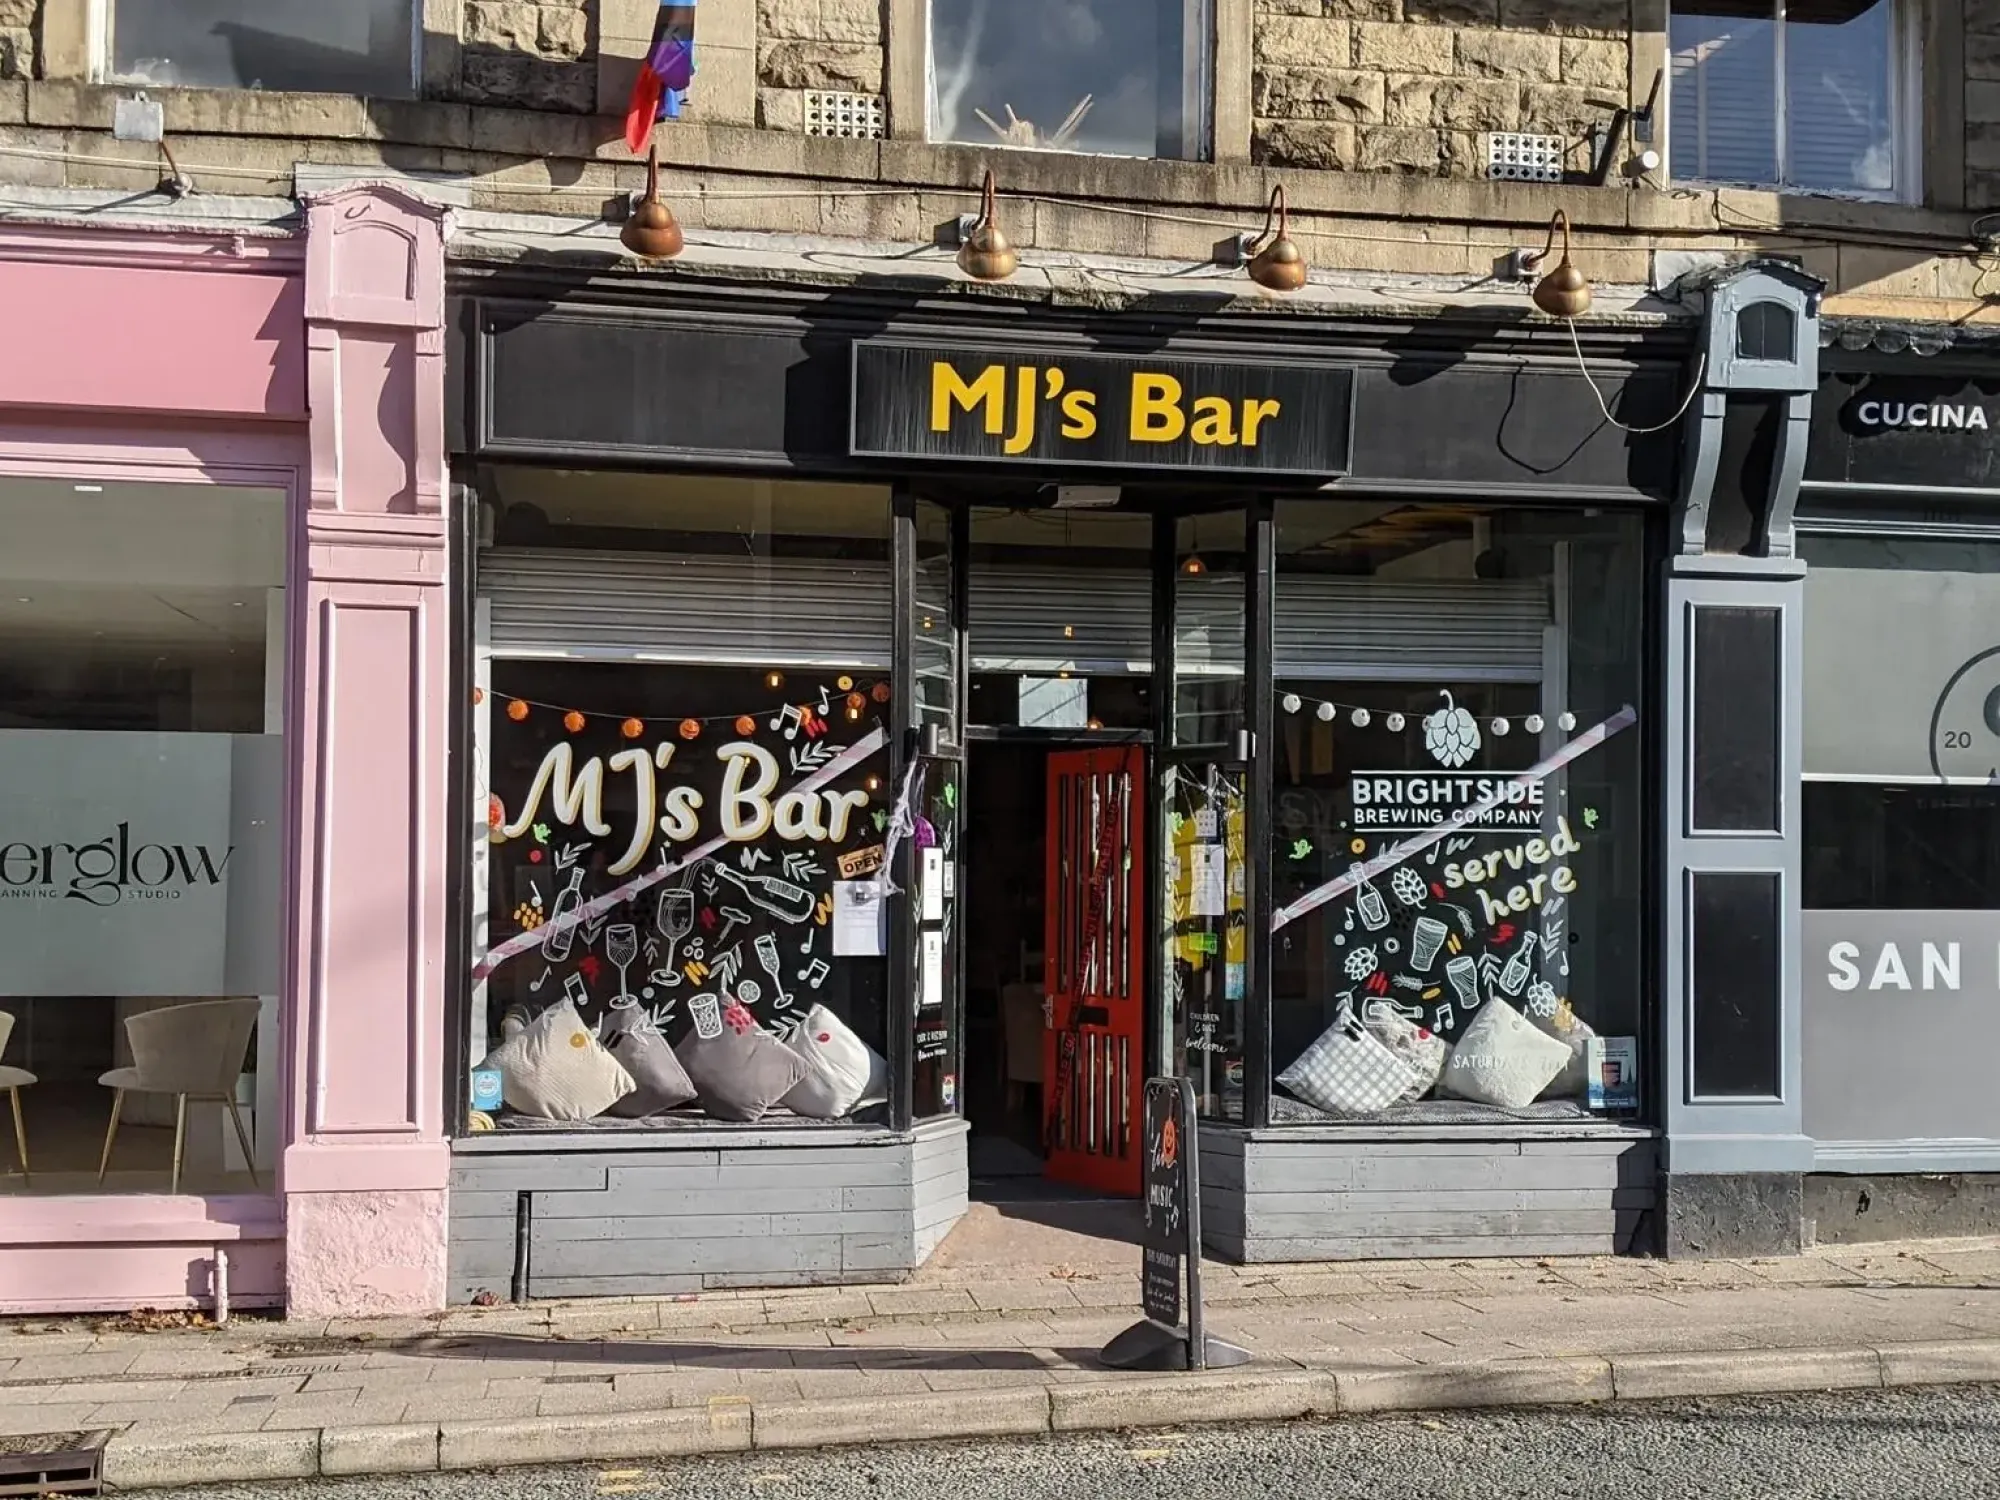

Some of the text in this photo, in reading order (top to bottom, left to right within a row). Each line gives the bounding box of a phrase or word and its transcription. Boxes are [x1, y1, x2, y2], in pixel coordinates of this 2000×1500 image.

[932, 361, 1281, 454] MJ's Bar
[1857, 401, 1989, 430] CUCINA
[1943, 730, 1972, 749] 20
[1352, 778, 1545, 805] BRIGHTSIDE
[502, 741, 870, 876] MJ's Bar
[1354, 808, 1545, 825] BREWING COMPANY
[0, 821, 236, 907] erglow
[843, 852, 884, 873] OPEN
[1443, 815, 1581, 889] served
[127, 889, 181, 899] STUDIO
[1475, 865, 1577, 926] here
[1828, 941, 1961, 991] SAN
[1185, 1036, 1229, 1053] welcome
[1150, 1184, 1174, 1208] MUSIC
